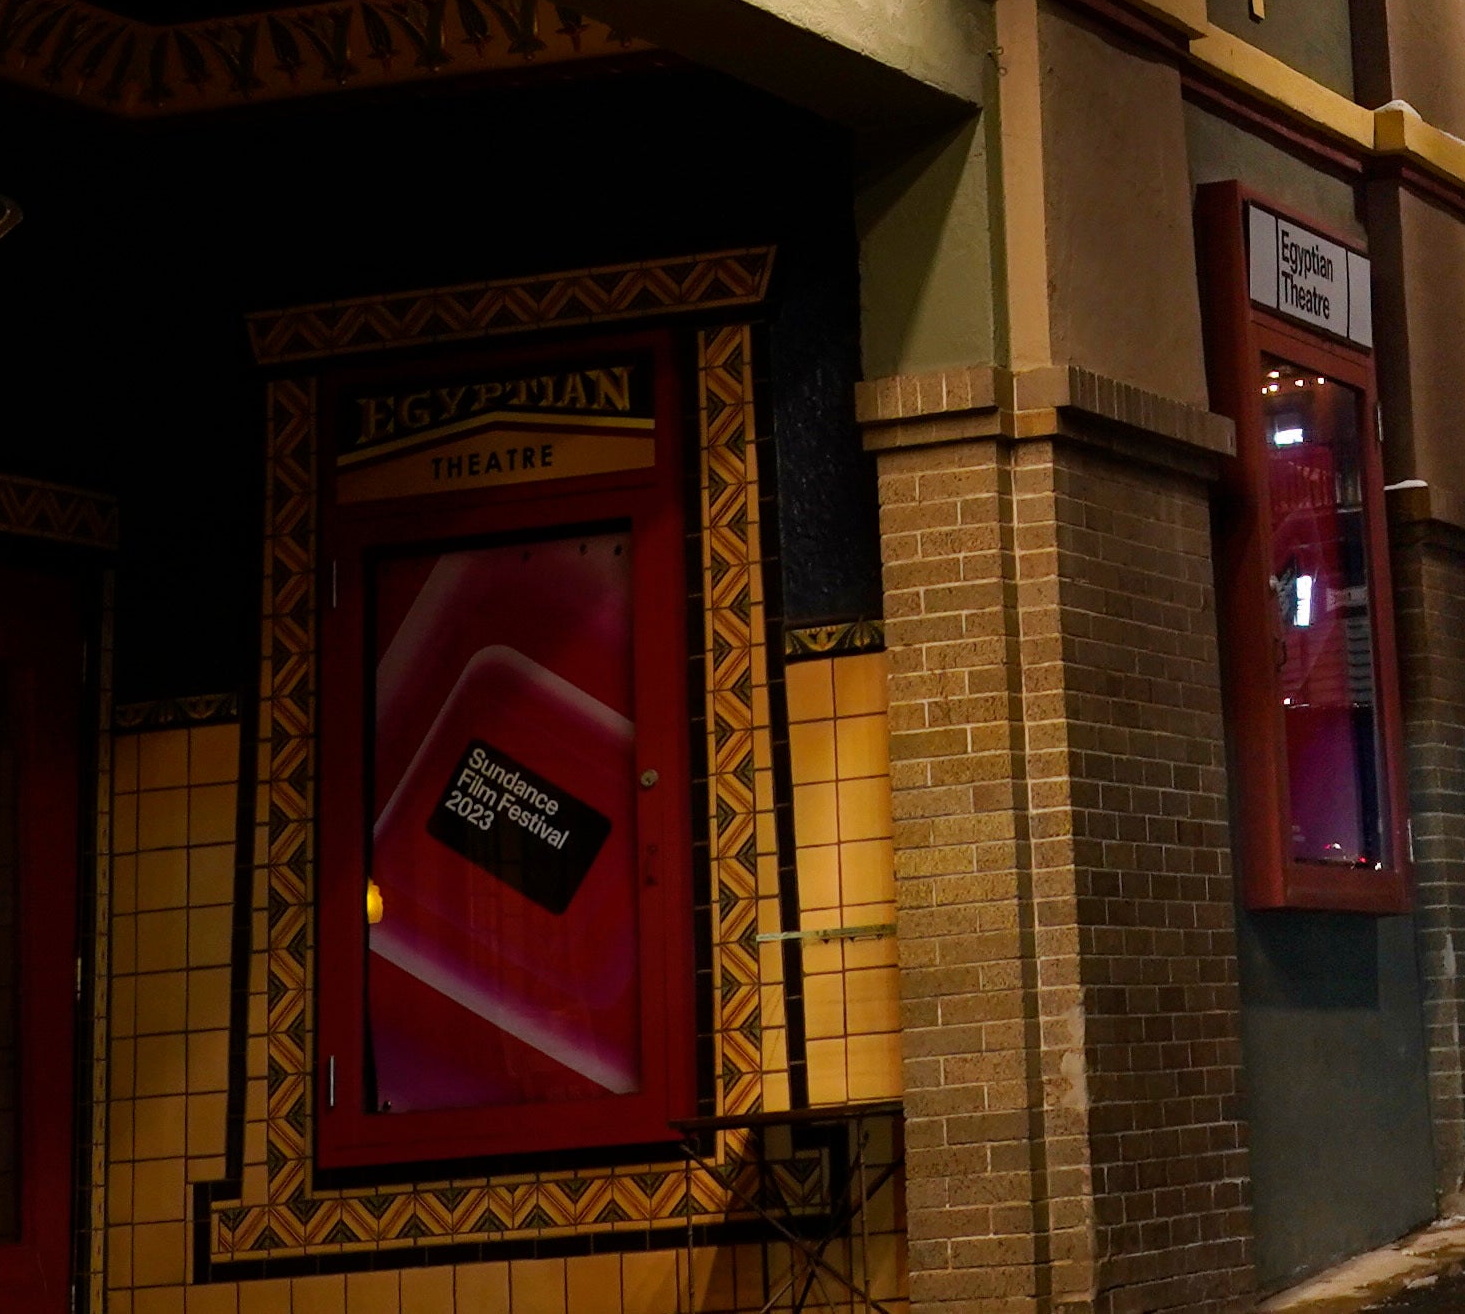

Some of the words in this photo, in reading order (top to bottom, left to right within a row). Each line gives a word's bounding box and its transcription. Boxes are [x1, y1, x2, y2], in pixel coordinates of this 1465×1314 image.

[1281, 229, 1334, 282] Egyptian
[1281, 270, 1330, 319] Theatre
[353, 365, 637, 446] EGYPTIAN
[431, 443, 555, 479] THEATRE
[468, 747, 559, 816] Sundance
[444, 789, 495, 830] 2023
[457, 767, 497, 808] Film
[497, 792, 571, 850] Festival
